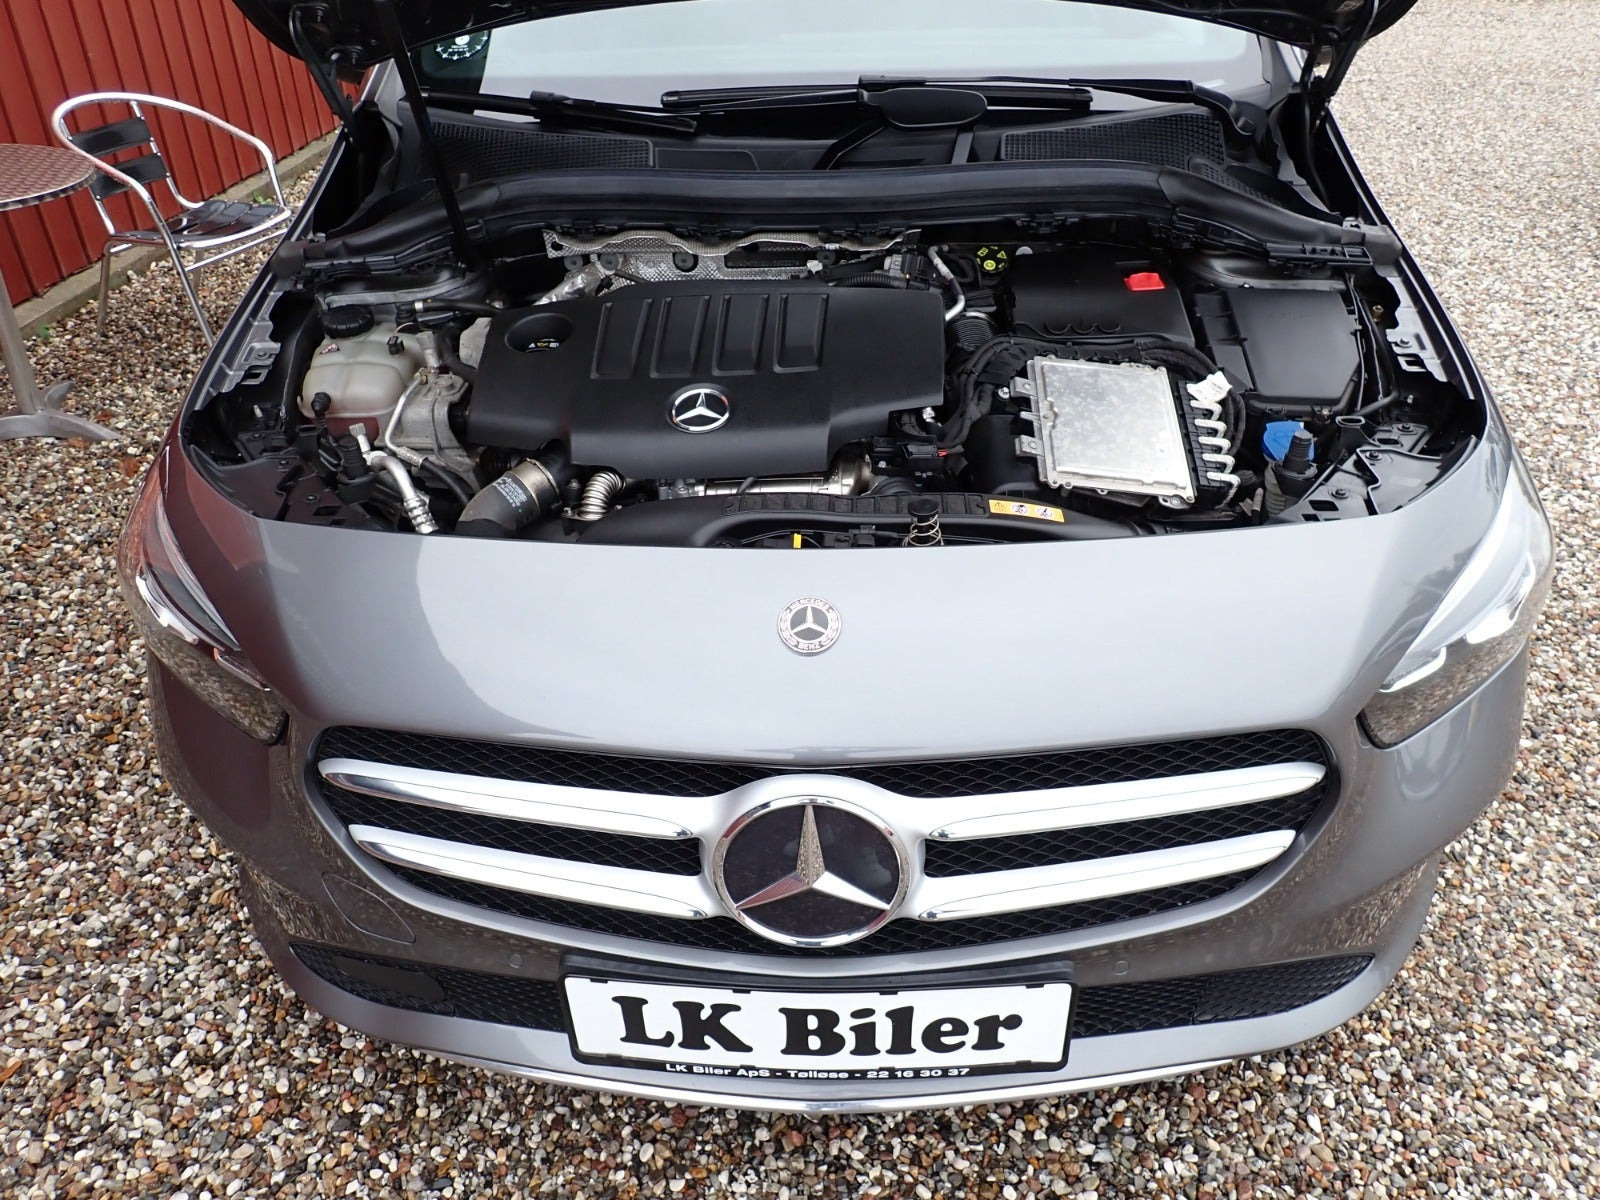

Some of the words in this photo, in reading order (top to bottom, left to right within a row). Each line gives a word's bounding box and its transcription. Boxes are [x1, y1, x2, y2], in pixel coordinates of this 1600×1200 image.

[798, 642, 821, 650] BENZ
[611, 995, 753, 1053] LK
[778, 1005, 1023, 1056] Biler
[665, 1063, 688, 1072] LK
[693, 1065, 731, 1075] Biler
[736, 1068, 770, 1077] ApS
[867, 1070, 889, 1078] 22
[895, 1070, 914, 1078] 16
[920, 1069, 942, 1077] 30
[948, 1068, 970, 1076] 37
